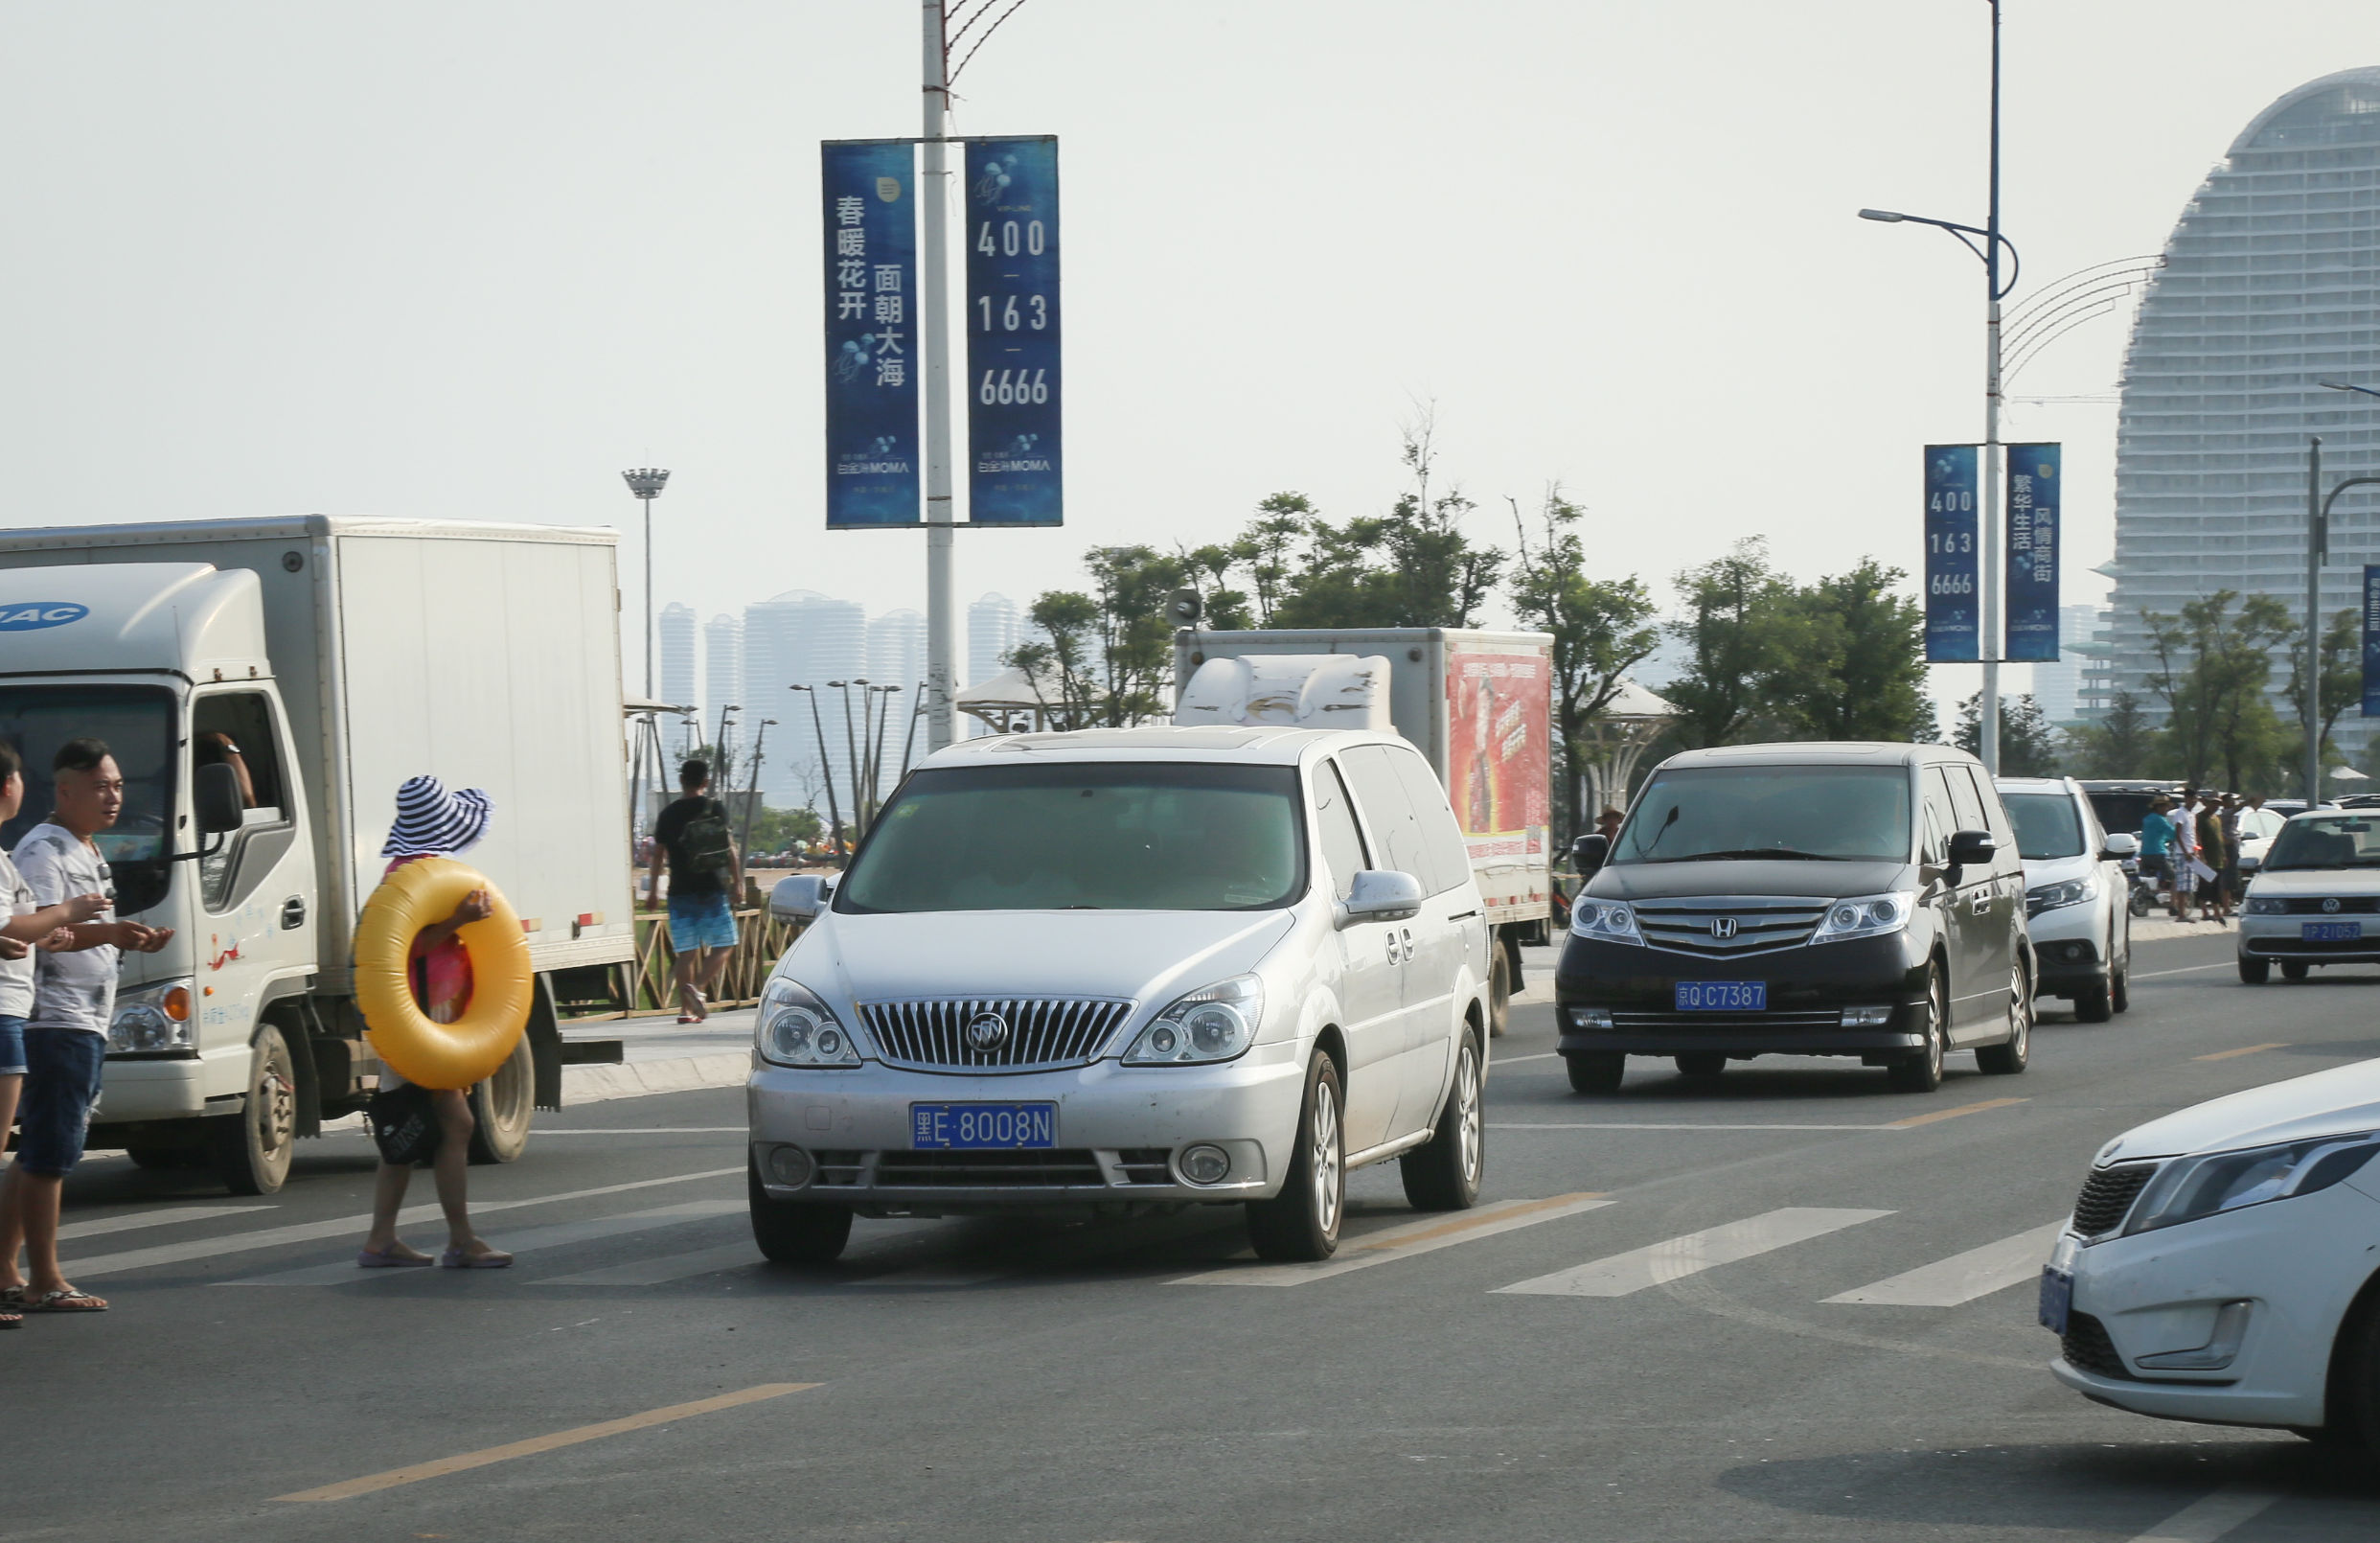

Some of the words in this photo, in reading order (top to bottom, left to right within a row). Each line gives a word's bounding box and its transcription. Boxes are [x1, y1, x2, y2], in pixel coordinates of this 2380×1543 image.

[977, 219, 1044, 257] 400
[836, 196, 866, 320] 春暖花开
[874, 264, 904, 387] 面朝大海
[978, 294, 1046, 332] 163
[980, 369, 1048, 405] 6666
[1931, 492, 1971, 512] 400
[2013, 474, 2032, 550] 繁华生活
[1931, 533, 1971, 553] 163
[2033, 507, 2052, 582] 风情商街
[1931, 573, 1972, 594] 6666
